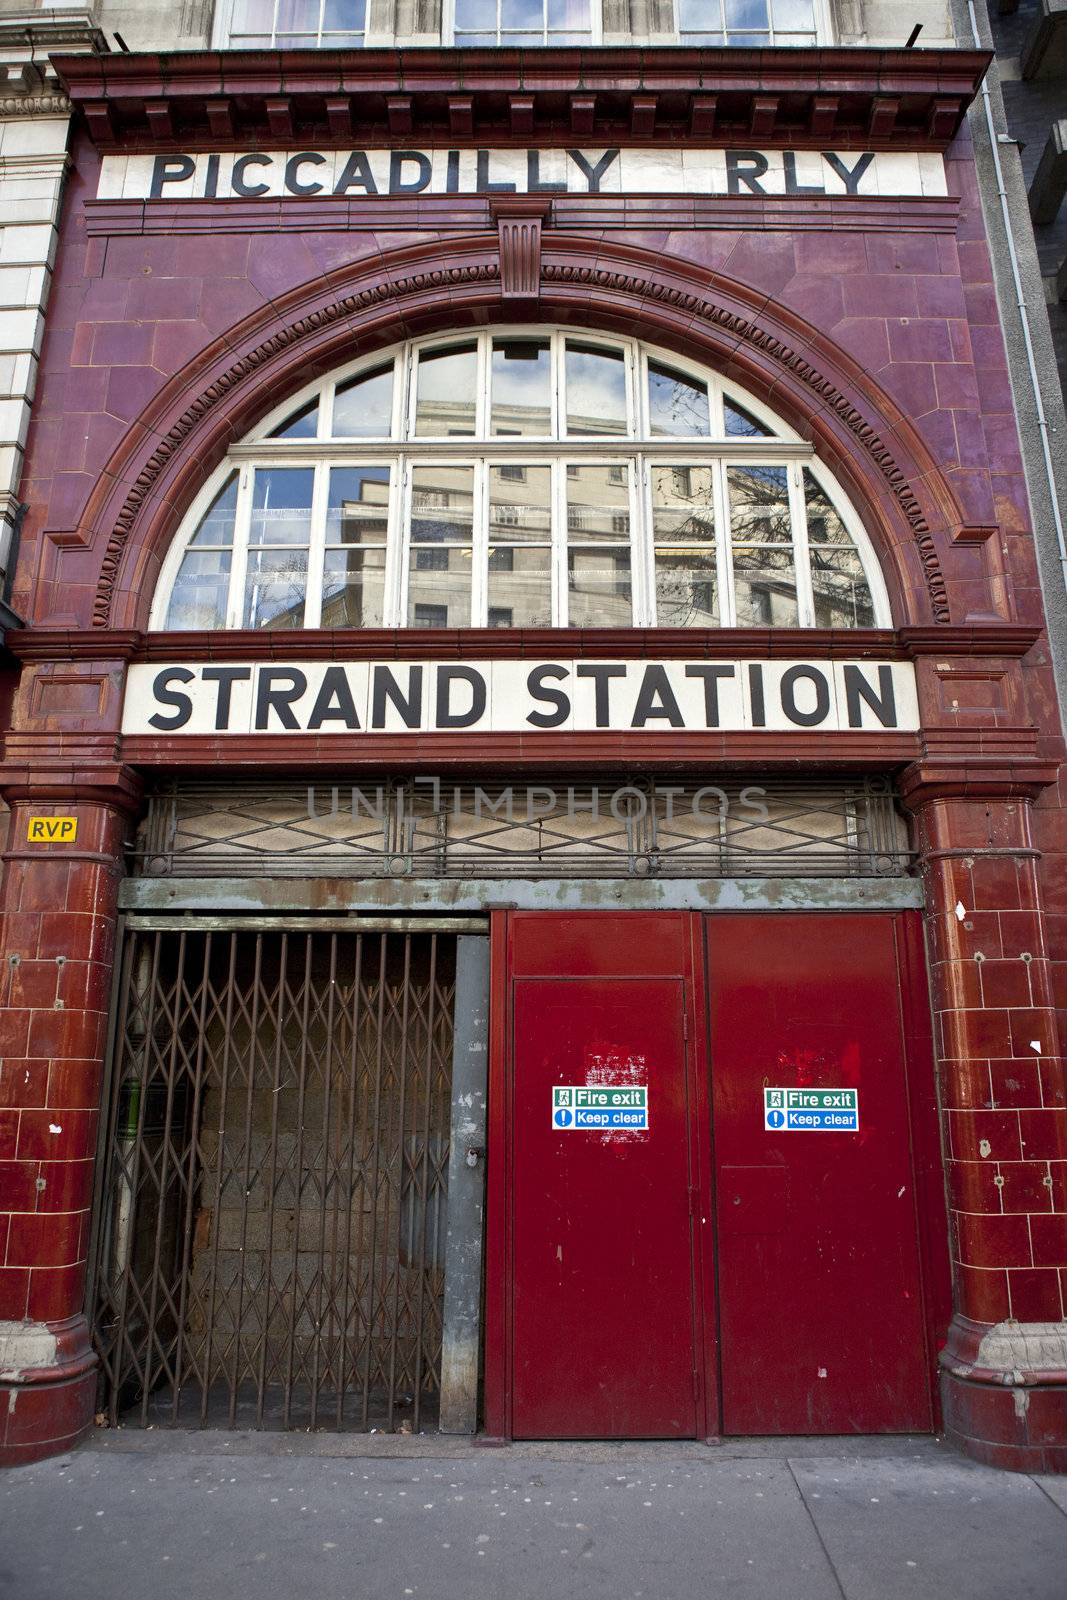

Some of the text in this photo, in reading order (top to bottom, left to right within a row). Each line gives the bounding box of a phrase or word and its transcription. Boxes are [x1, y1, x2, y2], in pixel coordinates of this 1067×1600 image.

[151, 149, 875, 198] PICCADILLY RLY
[147, 662, 897, 731] STRAND STATION
[33, 821, 73, 837] RVP
[577, 1090, 641, 1105] Fire exit
[788, 1092, 851, 1107] Fire exit
[577, 1112, 644, 1126] Keep clear
[789, 1113, 855, 1128] Keep clear
